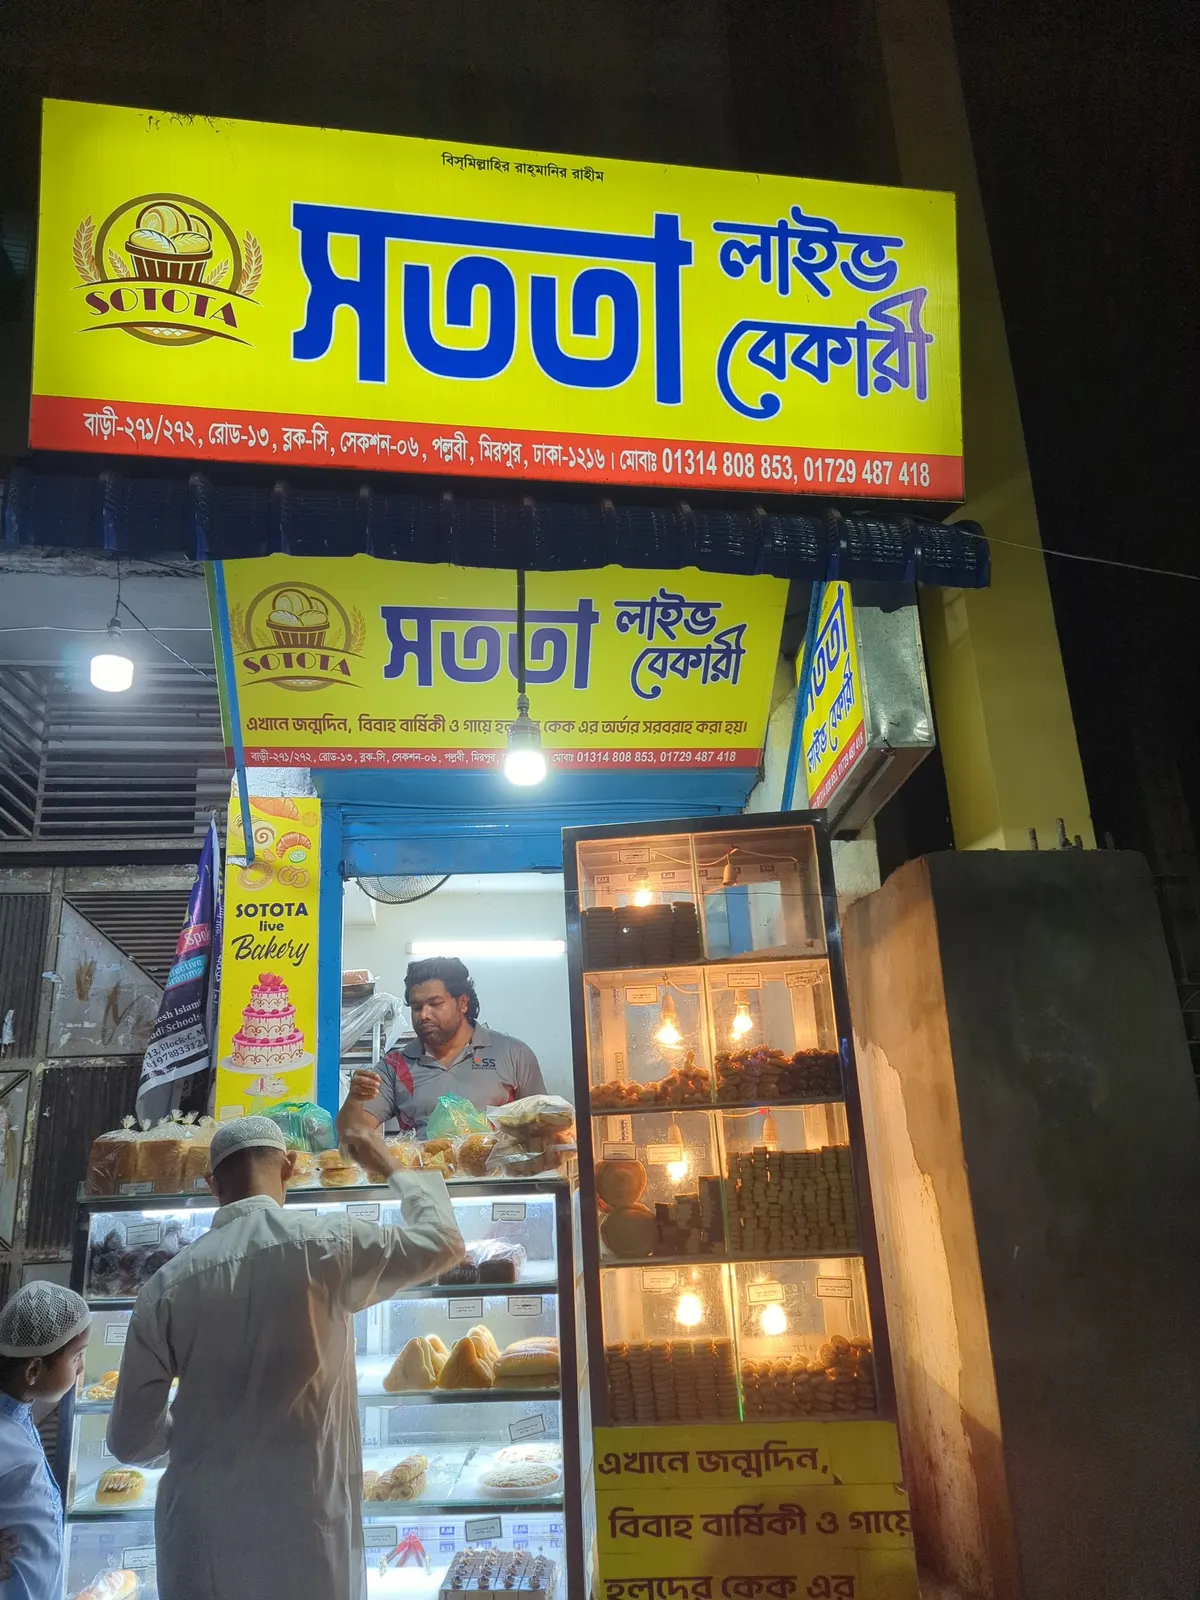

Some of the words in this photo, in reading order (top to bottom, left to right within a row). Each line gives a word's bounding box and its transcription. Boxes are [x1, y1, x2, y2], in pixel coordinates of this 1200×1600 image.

[571, 166, 604, 182] রাহীম
[712, 204, 904, 298] লাইভ
[85, 286, 238, 329] SOTOTA
[292, 201, 693, 405] সততা
[715, 287, 934, 420] বেকারী
[208, 422, 278, 453] রোড-১৩,
[281, 421, 335, 456] ব্লক-সি,
[432, 431, 475, 466] পল্লবী,
[478, 433, 528, 469] মিরপুর,
[662, 447, 717, 476] 01314
[722, 452, 755, 479] 808
[760, 454, 798, 485] 853,
[803, 456, 856, 484] 01729
[861, 460, 893, 486] 487
[898, 461, 930, 487] 418
[614, 587, 722, 641] লাইভ
[380, 598, 599, 690] সততা
[630, 623, 747, 700] বেকারী
[805, 583, 848, 713] ততা
[243, 651, 351, 677] SOTOTA
[246, 717, 289, 732] এখানে
[292, 713, 352, 735] জন্মদিন,
[358, 713, 396, 733] বিবাহ
[399, 713, 446, 733] বার্ষিকী
[450, 720, 460, 732] ও
[464, 719, 493, 735] গায়ে
[544, 720, 576, 733] কেক
[578, 720, 599, 734] এর
[602, 715, 640, 734] অর্ডার
[642, 720, 693, 735] সরবরাহ
[696, 720, 722, 734] করা
[577, 751, 609, 763] 01314
[612, 751, 632, 763] 808
[634, 751, 657, 764] 853,
[660, 751, 692, 762] 01729
[694, 751, 714, 762] 487
[716, 751, 737, 762] 418
[235, 902, 309, 918] SOTOTA
[259, 920, 285, 932] live
[231, 934, 309, 967] Bakery
[598, 1450, 689, 1475] এখানে
[696, 1440, 829, 1478] জন্মদিন,
[608, 1506, 694, 1540] বিবাহ
[699, 1503, 807, 1537] বার্ষিকী
[815, 1511, 839, 1534] ও
[849, 1510, 912, 1537] গায়ে
[722, 1575, 797, 1599] কেক
[806, 1575, 855, 1600] এর
